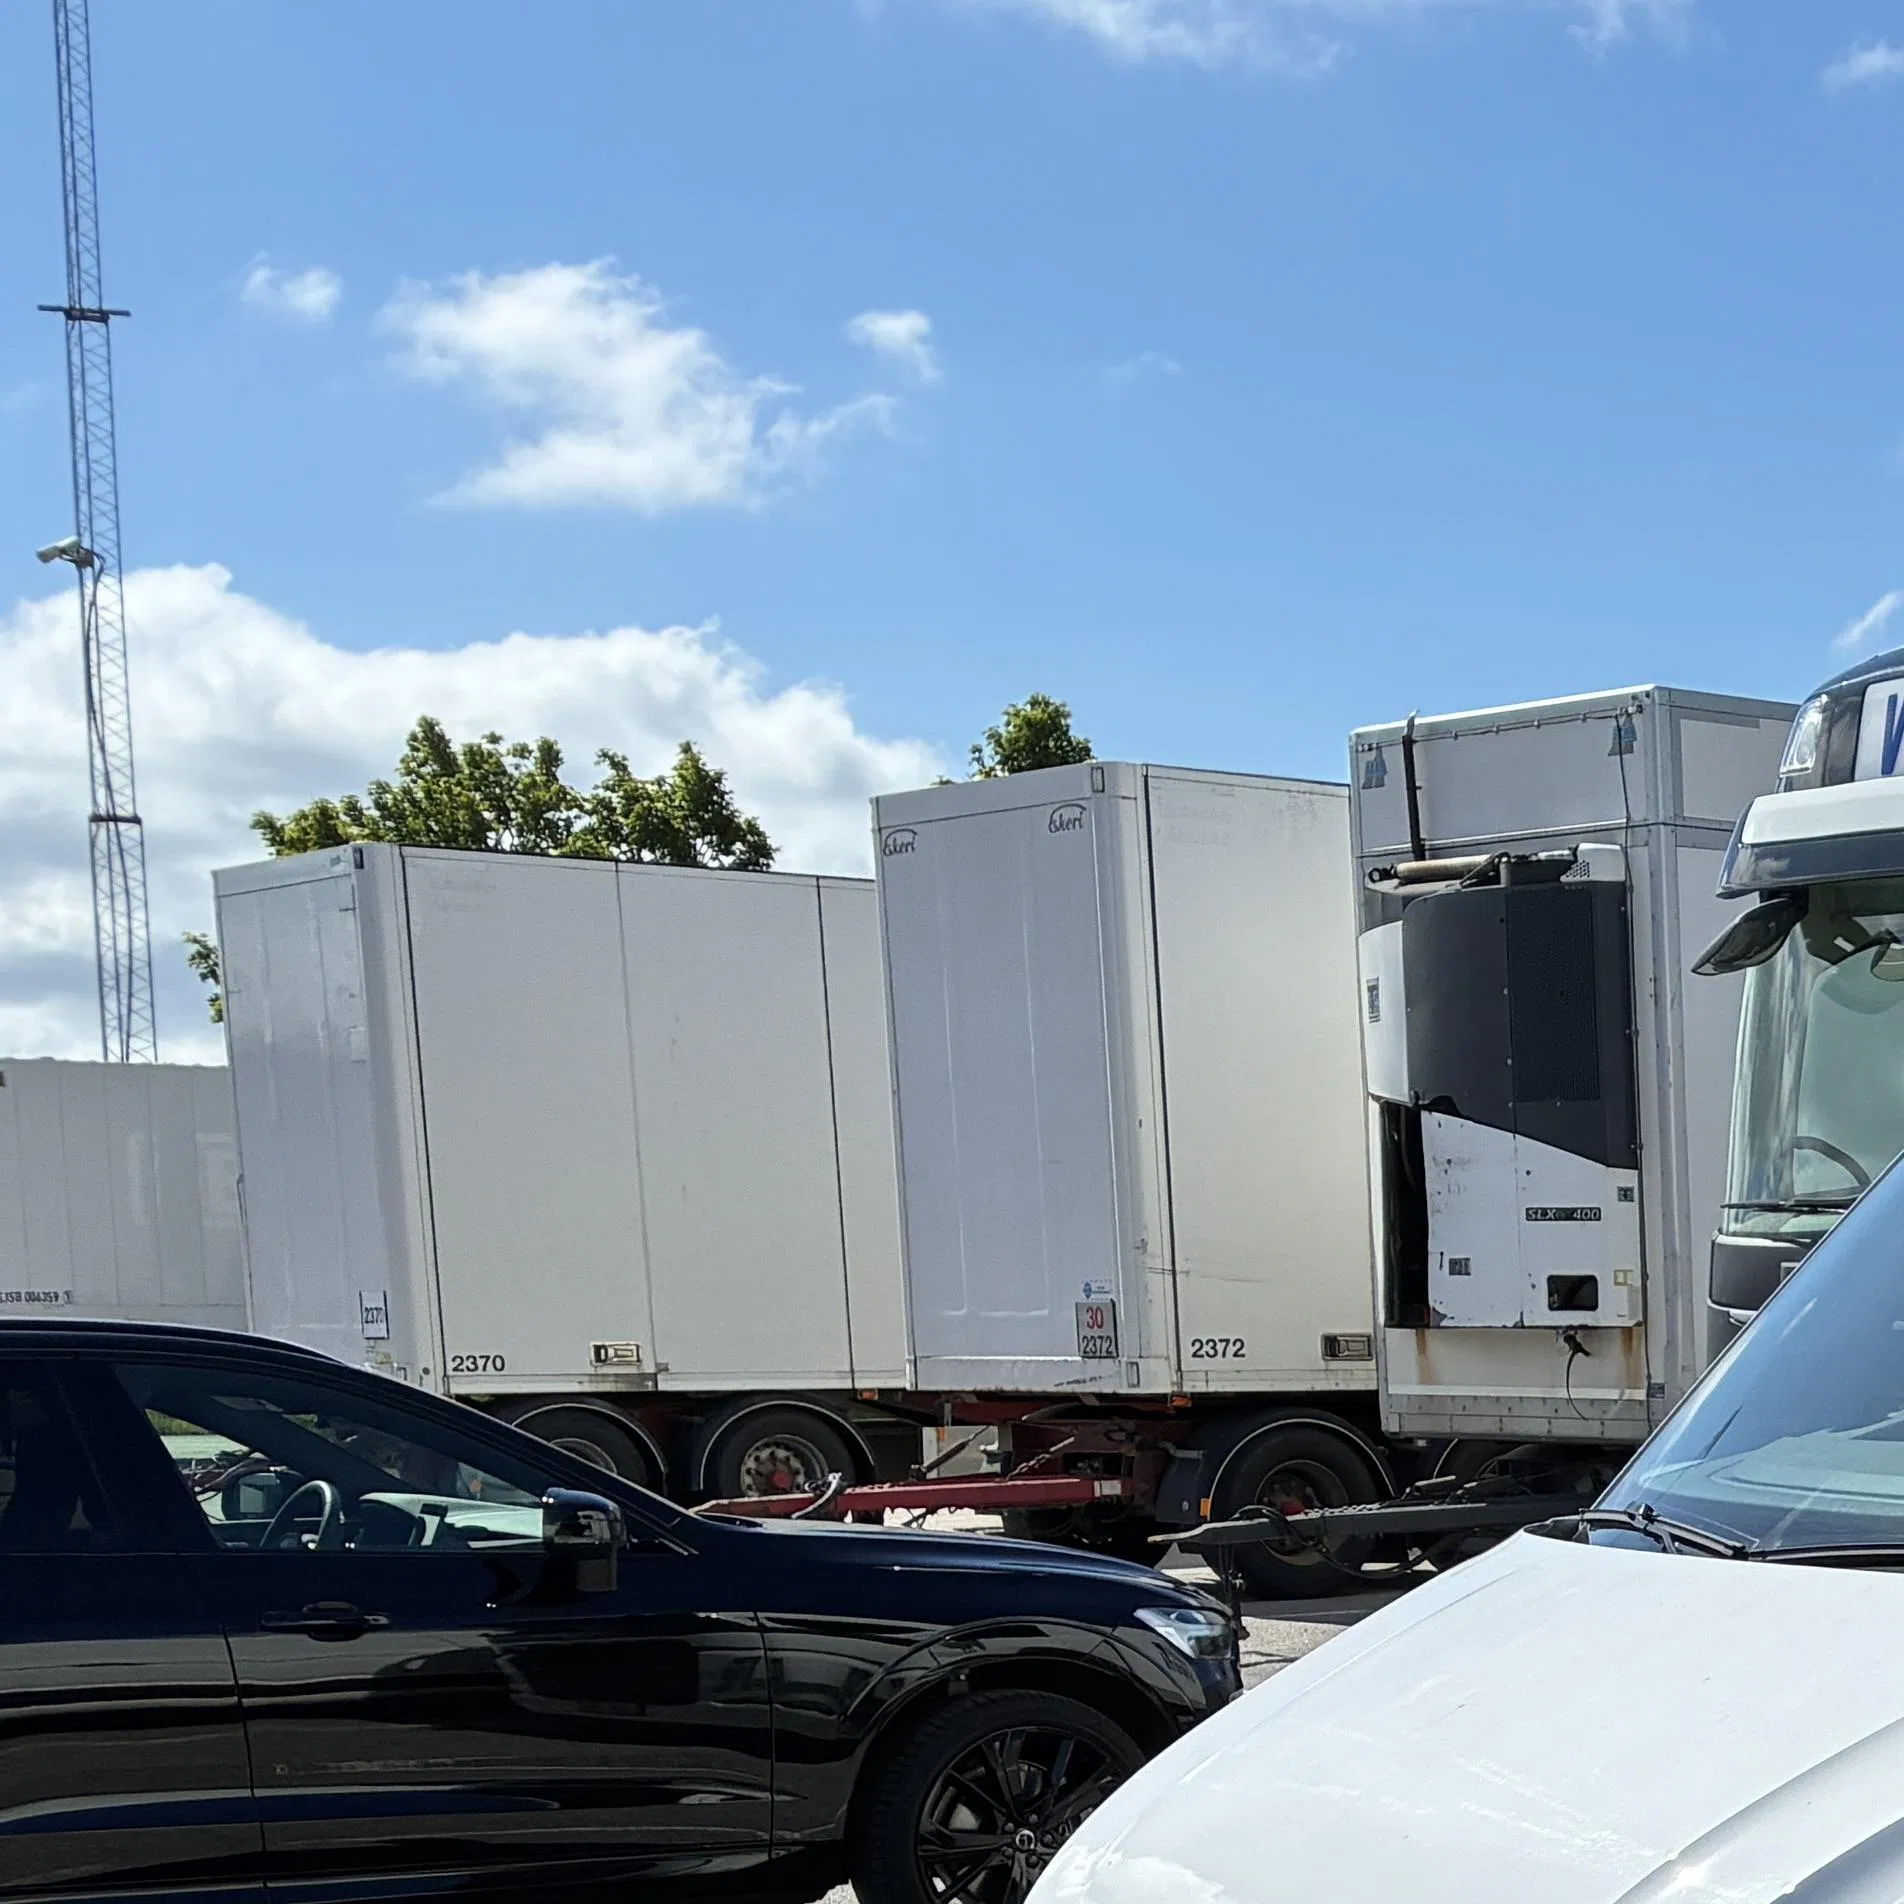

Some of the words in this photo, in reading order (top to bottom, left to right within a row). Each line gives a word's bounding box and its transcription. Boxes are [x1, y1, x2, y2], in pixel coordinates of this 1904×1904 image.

[1528, 1208, 1562, 1221] SLX
[1573, 1208, 1600, 1221] 400
[1086, 1306, 1104, 1329] 30
[1081, 1335, 1113, 1355] 2372
[1191, 1338, 1246, 1358] 2372
[451, 1354, 505, 1372] 2370
